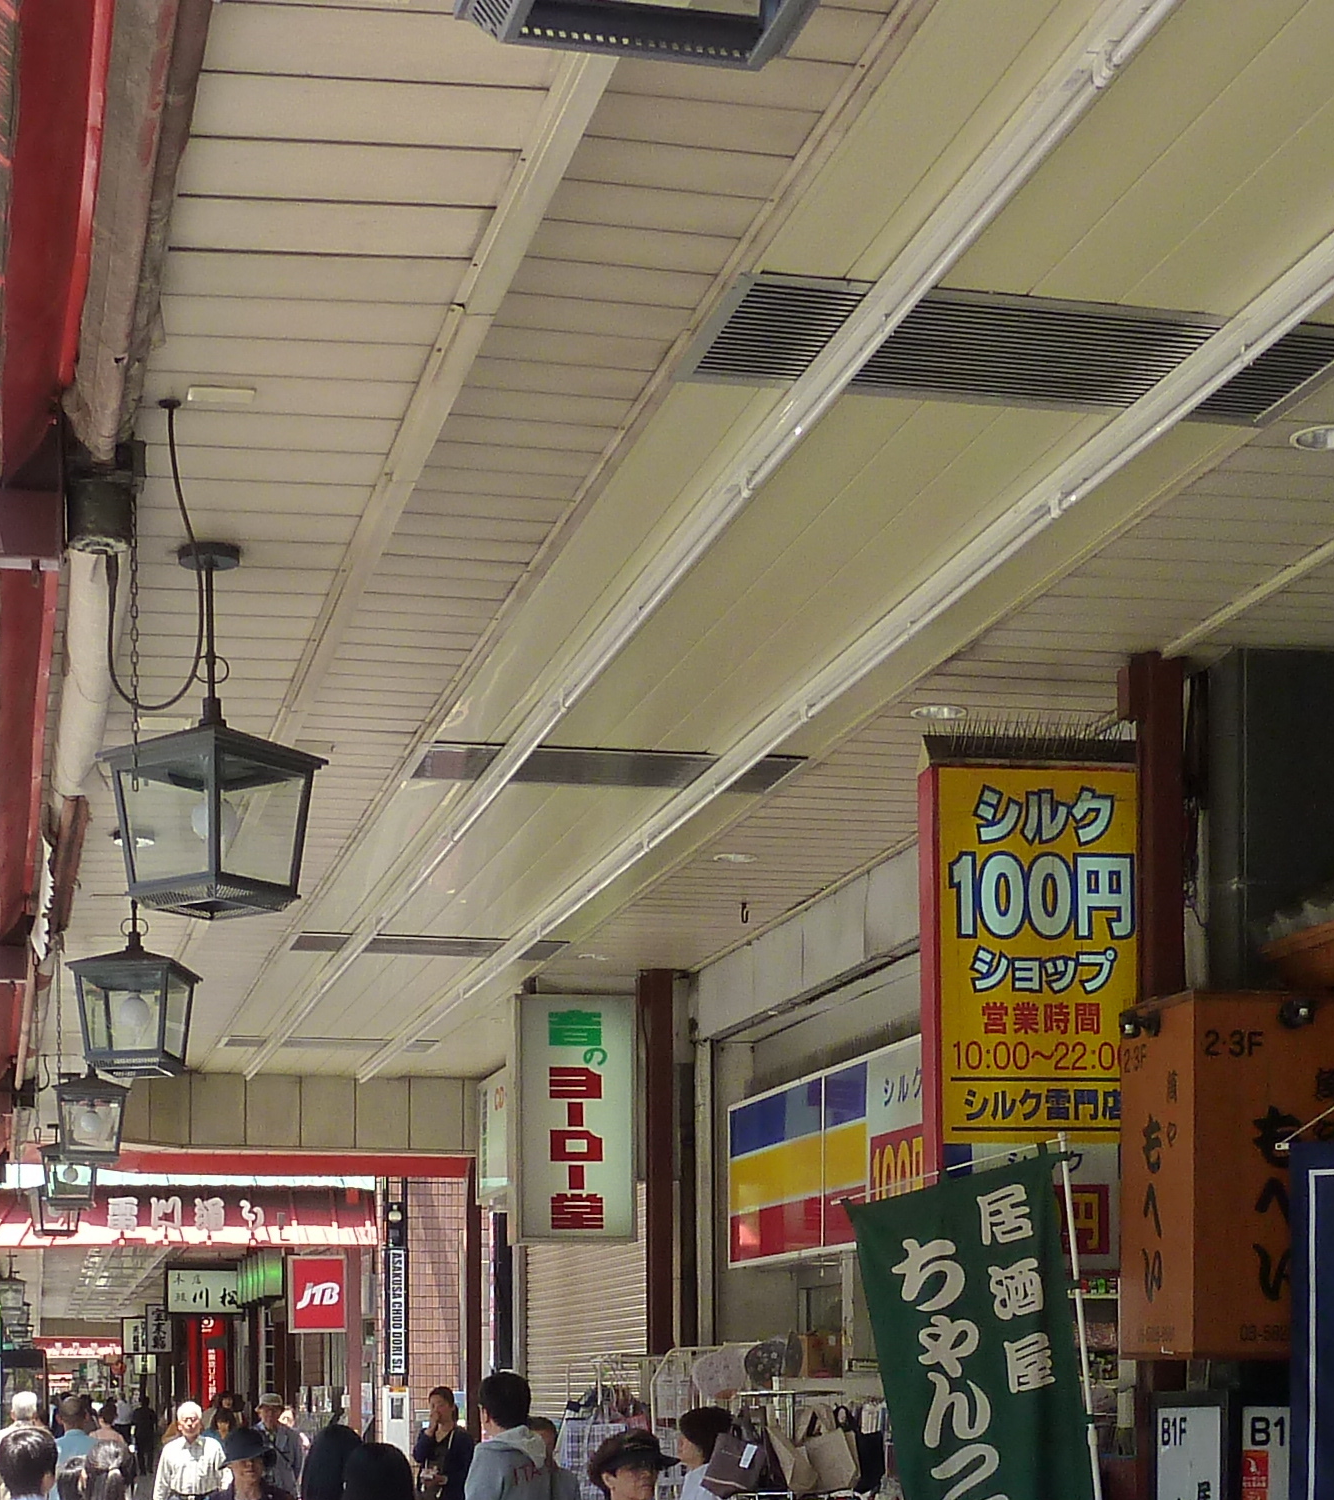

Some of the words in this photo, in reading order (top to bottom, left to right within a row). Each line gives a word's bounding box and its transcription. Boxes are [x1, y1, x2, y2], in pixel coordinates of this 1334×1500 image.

[973, 784, 1115, 845] シルク
[948, 850, 1136, 940] 100円
[969, 944, 1117, 993] ショップ
[981, 1001, 1101, 1035] 営業時間
[884, 1066, 923, 1107] シルク
[108, 1195, 266, 1232] 雷門通り
[391, 1253, 403, 1297] ASAKUSA
[976, 1183, 1056, 1394] 居酒屋
[296, 1282, 340, 1310] JTB
[391, 1301, 403, 1329] CHUO
[391, 1332, 403, 1357] DORI
[1161, 1416, 1187, 1447] B1F
